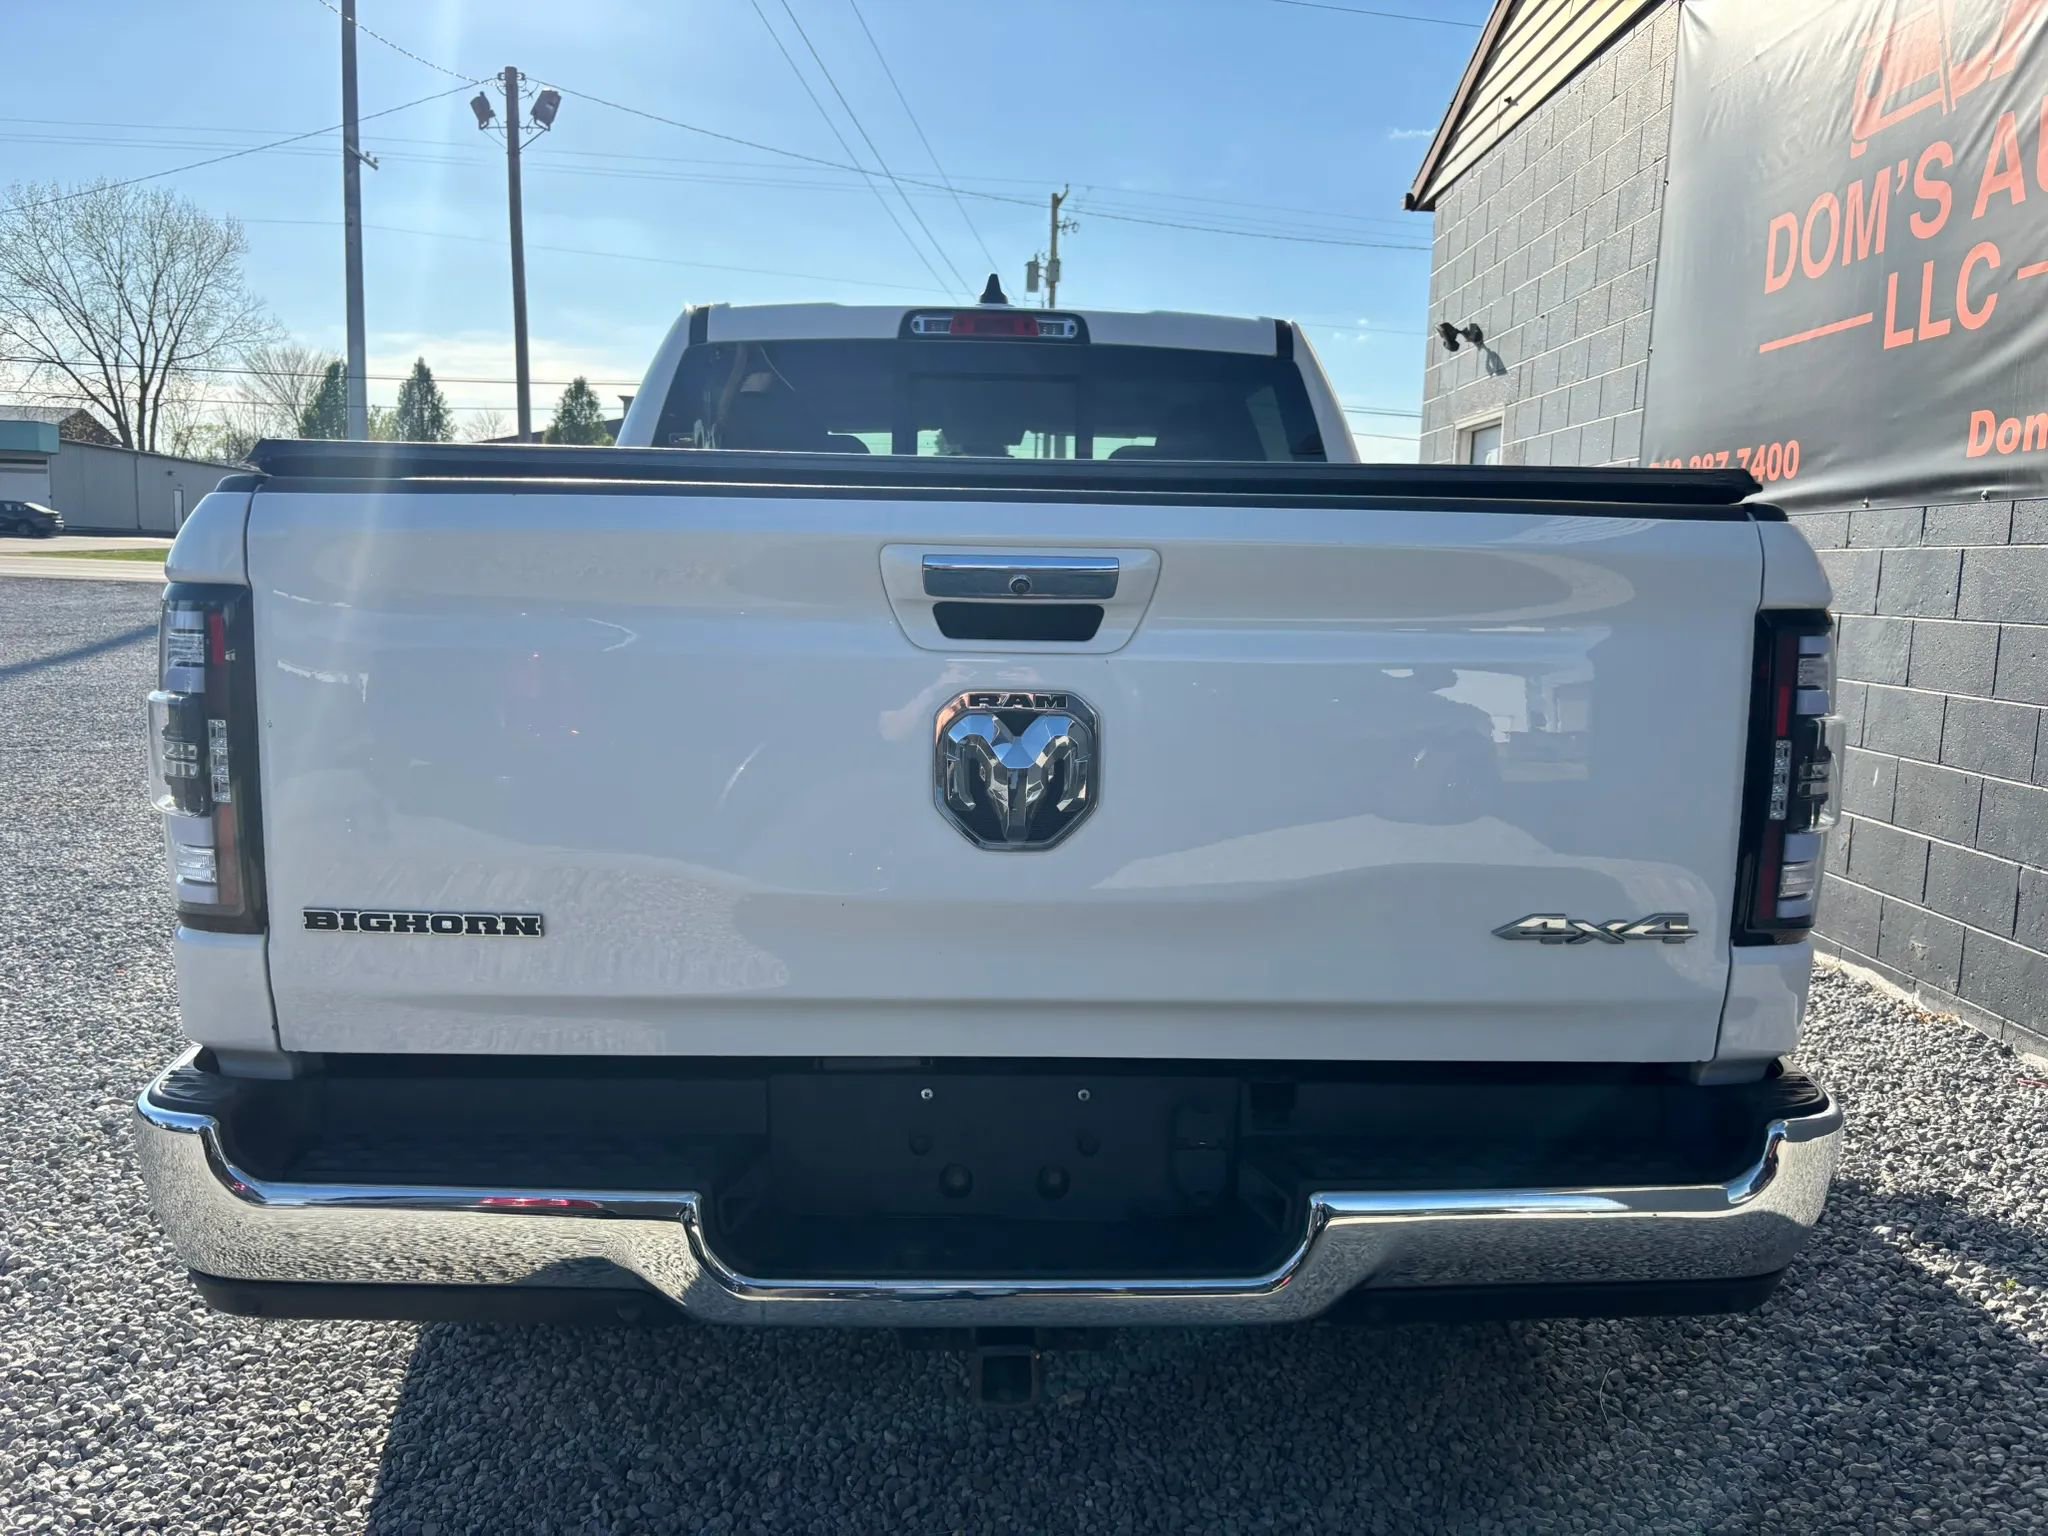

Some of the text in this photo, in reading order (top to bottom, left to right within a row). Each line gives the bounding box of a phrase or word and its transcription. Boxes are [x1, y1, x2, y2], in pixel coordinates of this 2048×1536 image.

[1763, 140, 1955, 296] DOM'S
[1883, 241, 2001, 350] LLC
[968, 693, 1068, 709] RAM
[302, 908, 545, 938] BIGHORN
